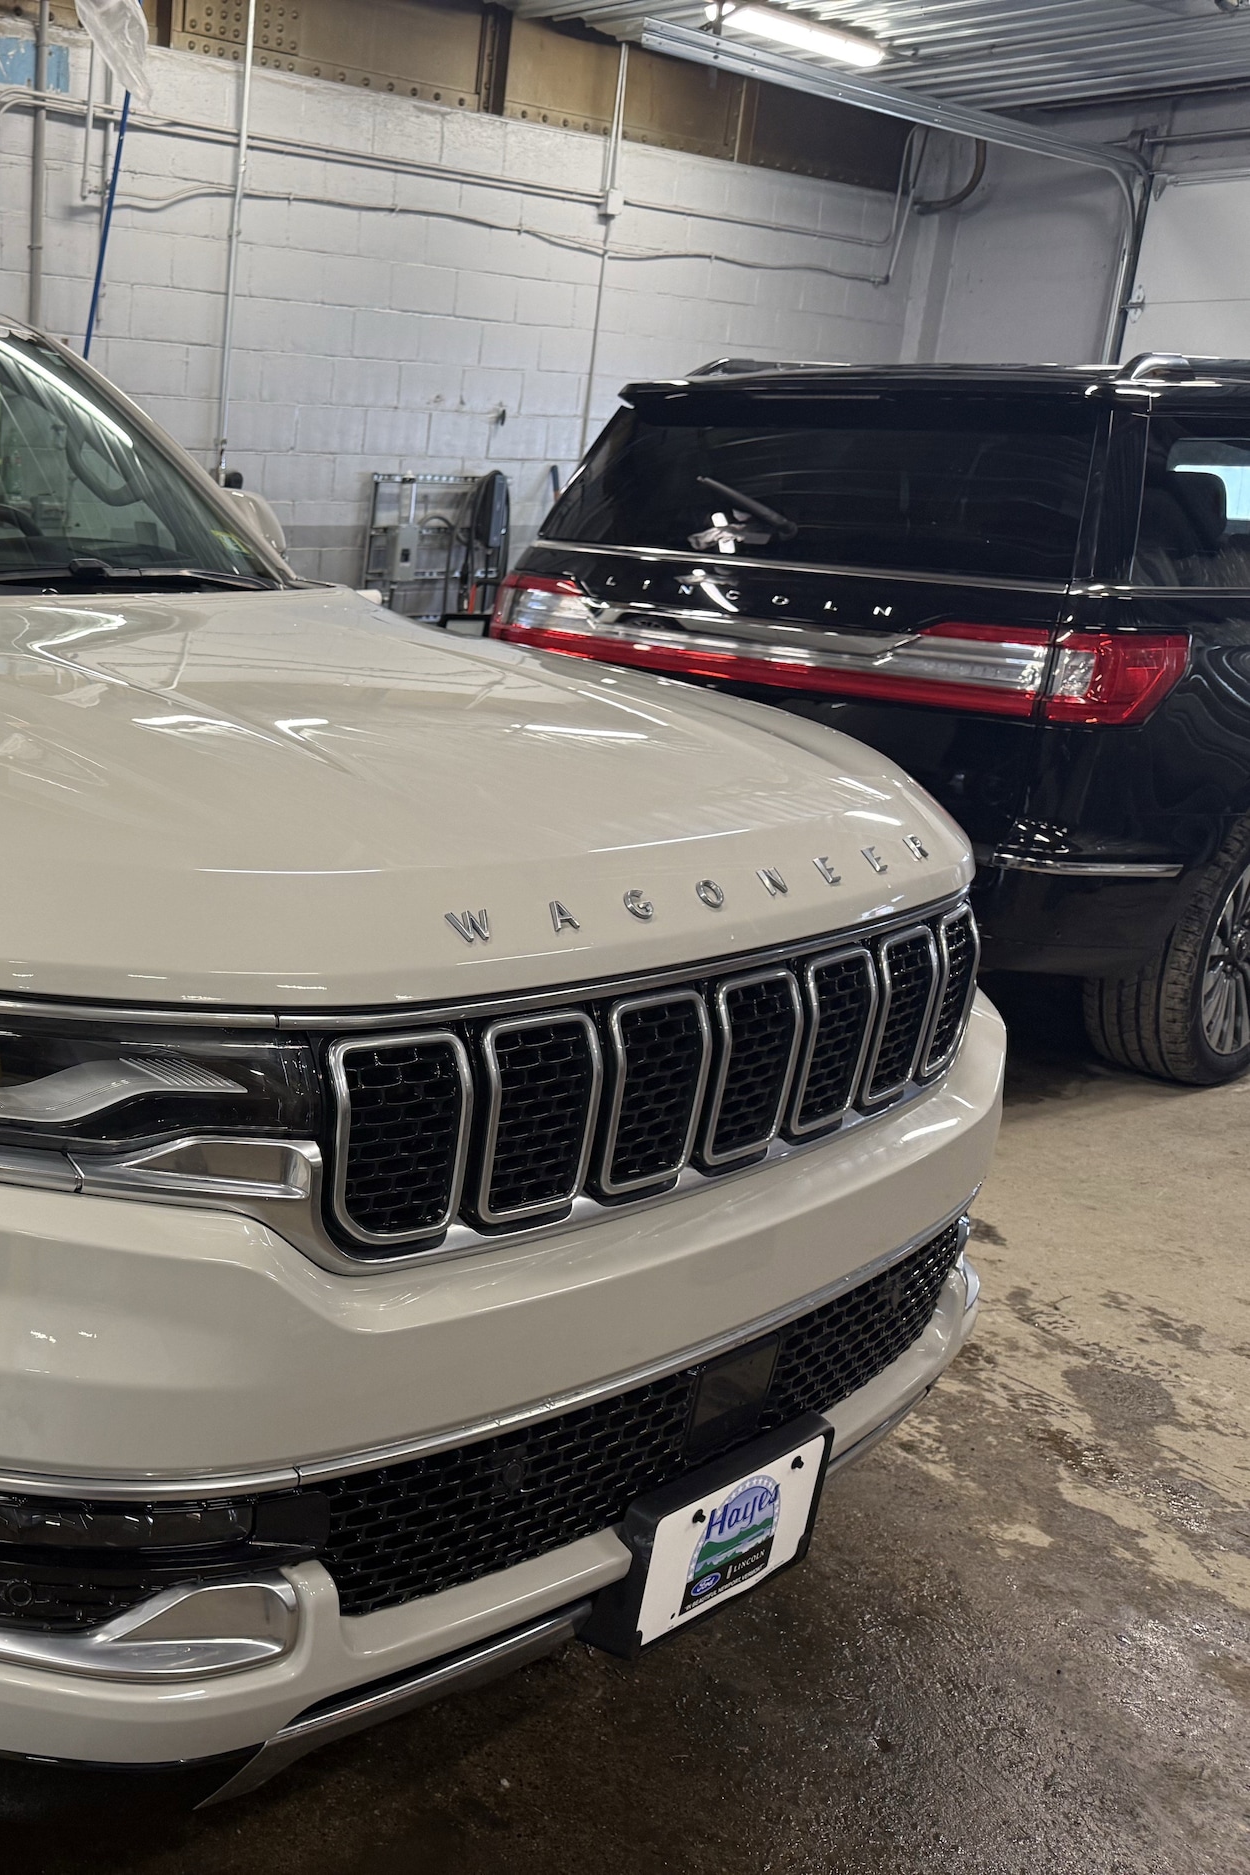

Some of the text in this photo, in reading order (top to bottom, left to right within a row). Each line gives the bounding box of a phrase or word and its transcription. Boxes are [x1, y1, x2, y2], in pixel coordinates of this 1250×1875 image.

[605, 575, 893, 617] LINCOLN
[443, 833, 930, 943] WAGONEER
[704, 1483, 781, 1542] Hayes
[733, 1549, 766, 1573] LINCOLN
[694, 1575, 718, 1594] Ford
